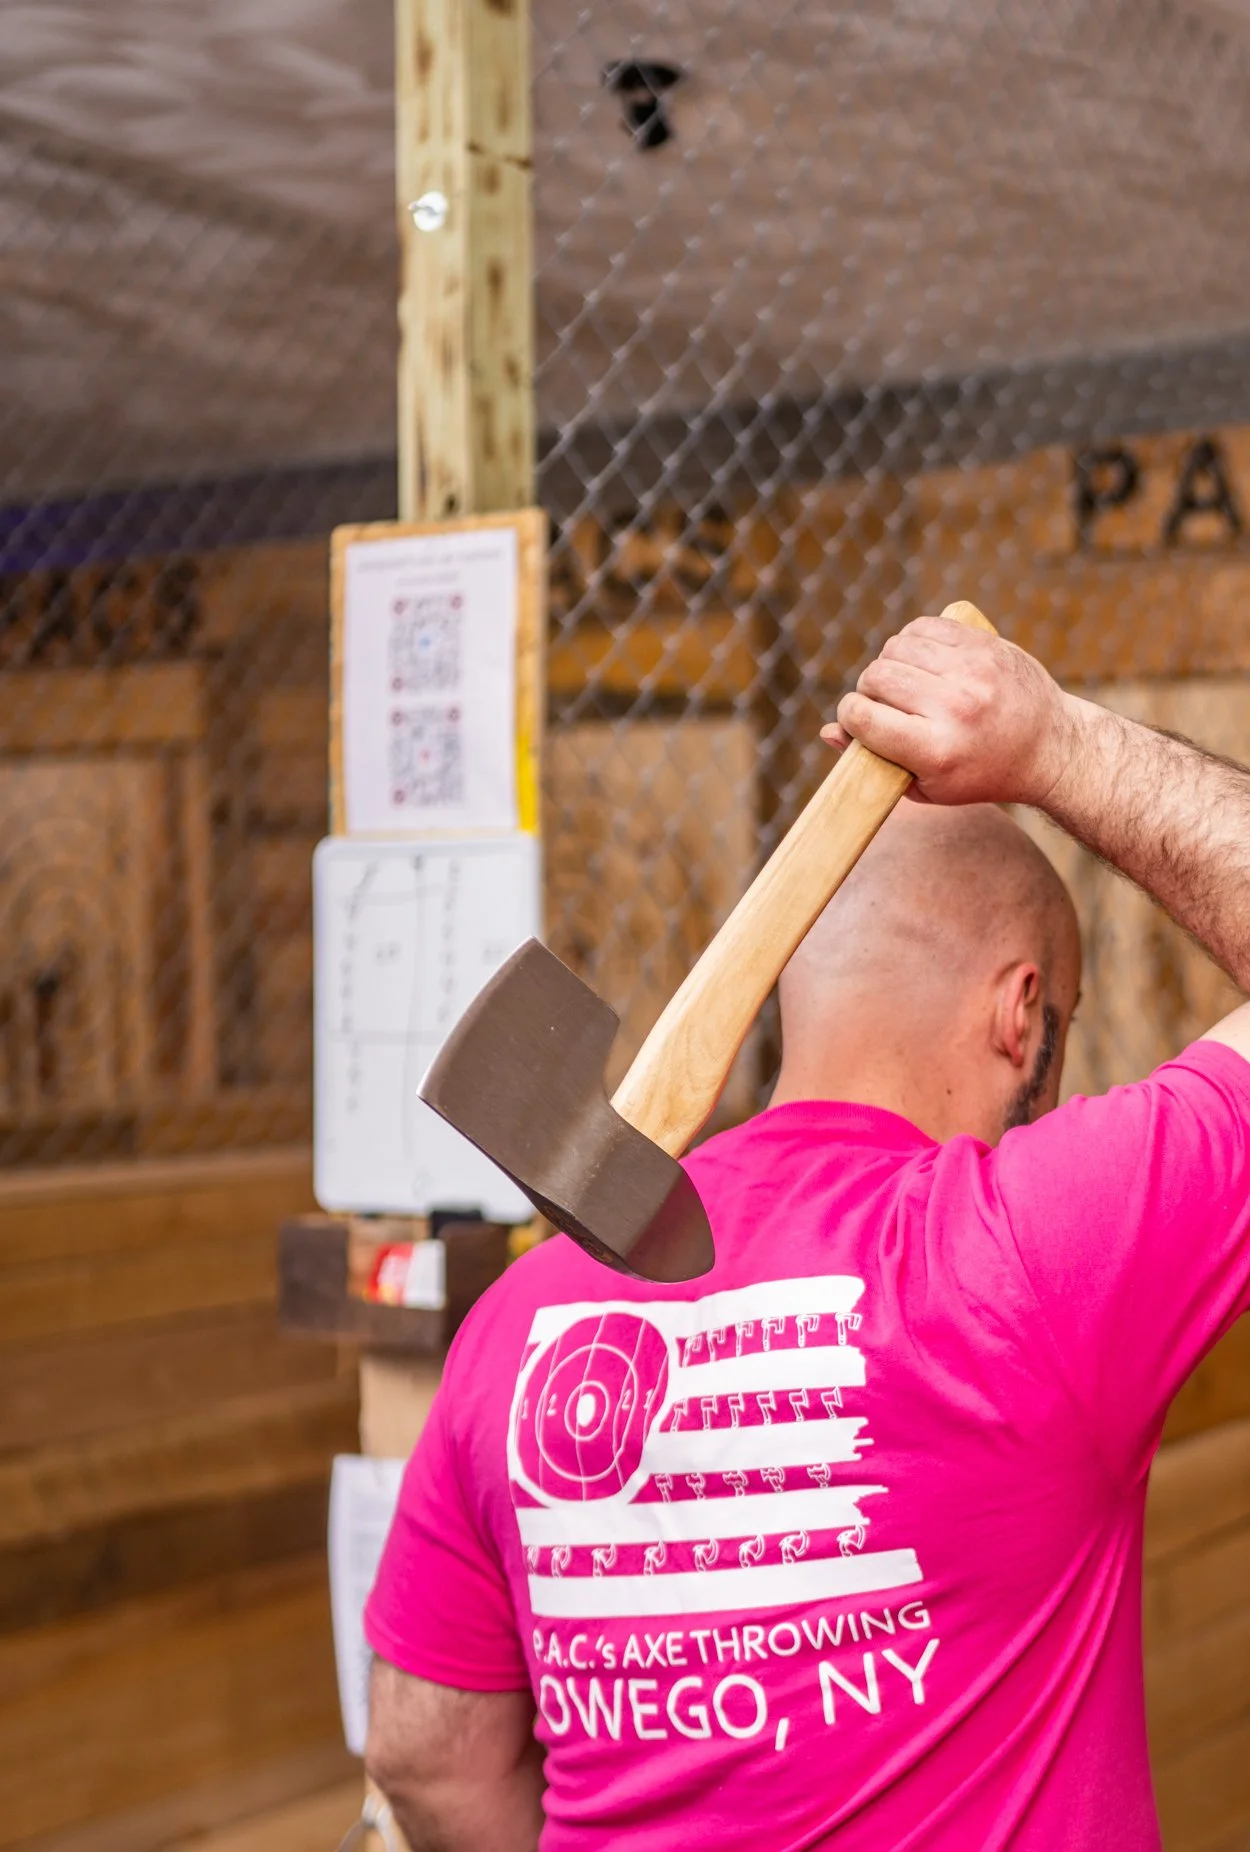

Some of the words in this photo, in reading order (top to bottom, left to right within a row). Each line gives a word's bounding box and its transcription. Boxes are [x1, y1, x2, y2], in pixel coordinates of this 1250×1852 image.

[622, 1632, 687, 1668] AXE
[689, 1601, 931, 1664] THROWING
[539, 1674, 790, 1751] OWEGO,
[818, 1638, 941, 1725] NY
